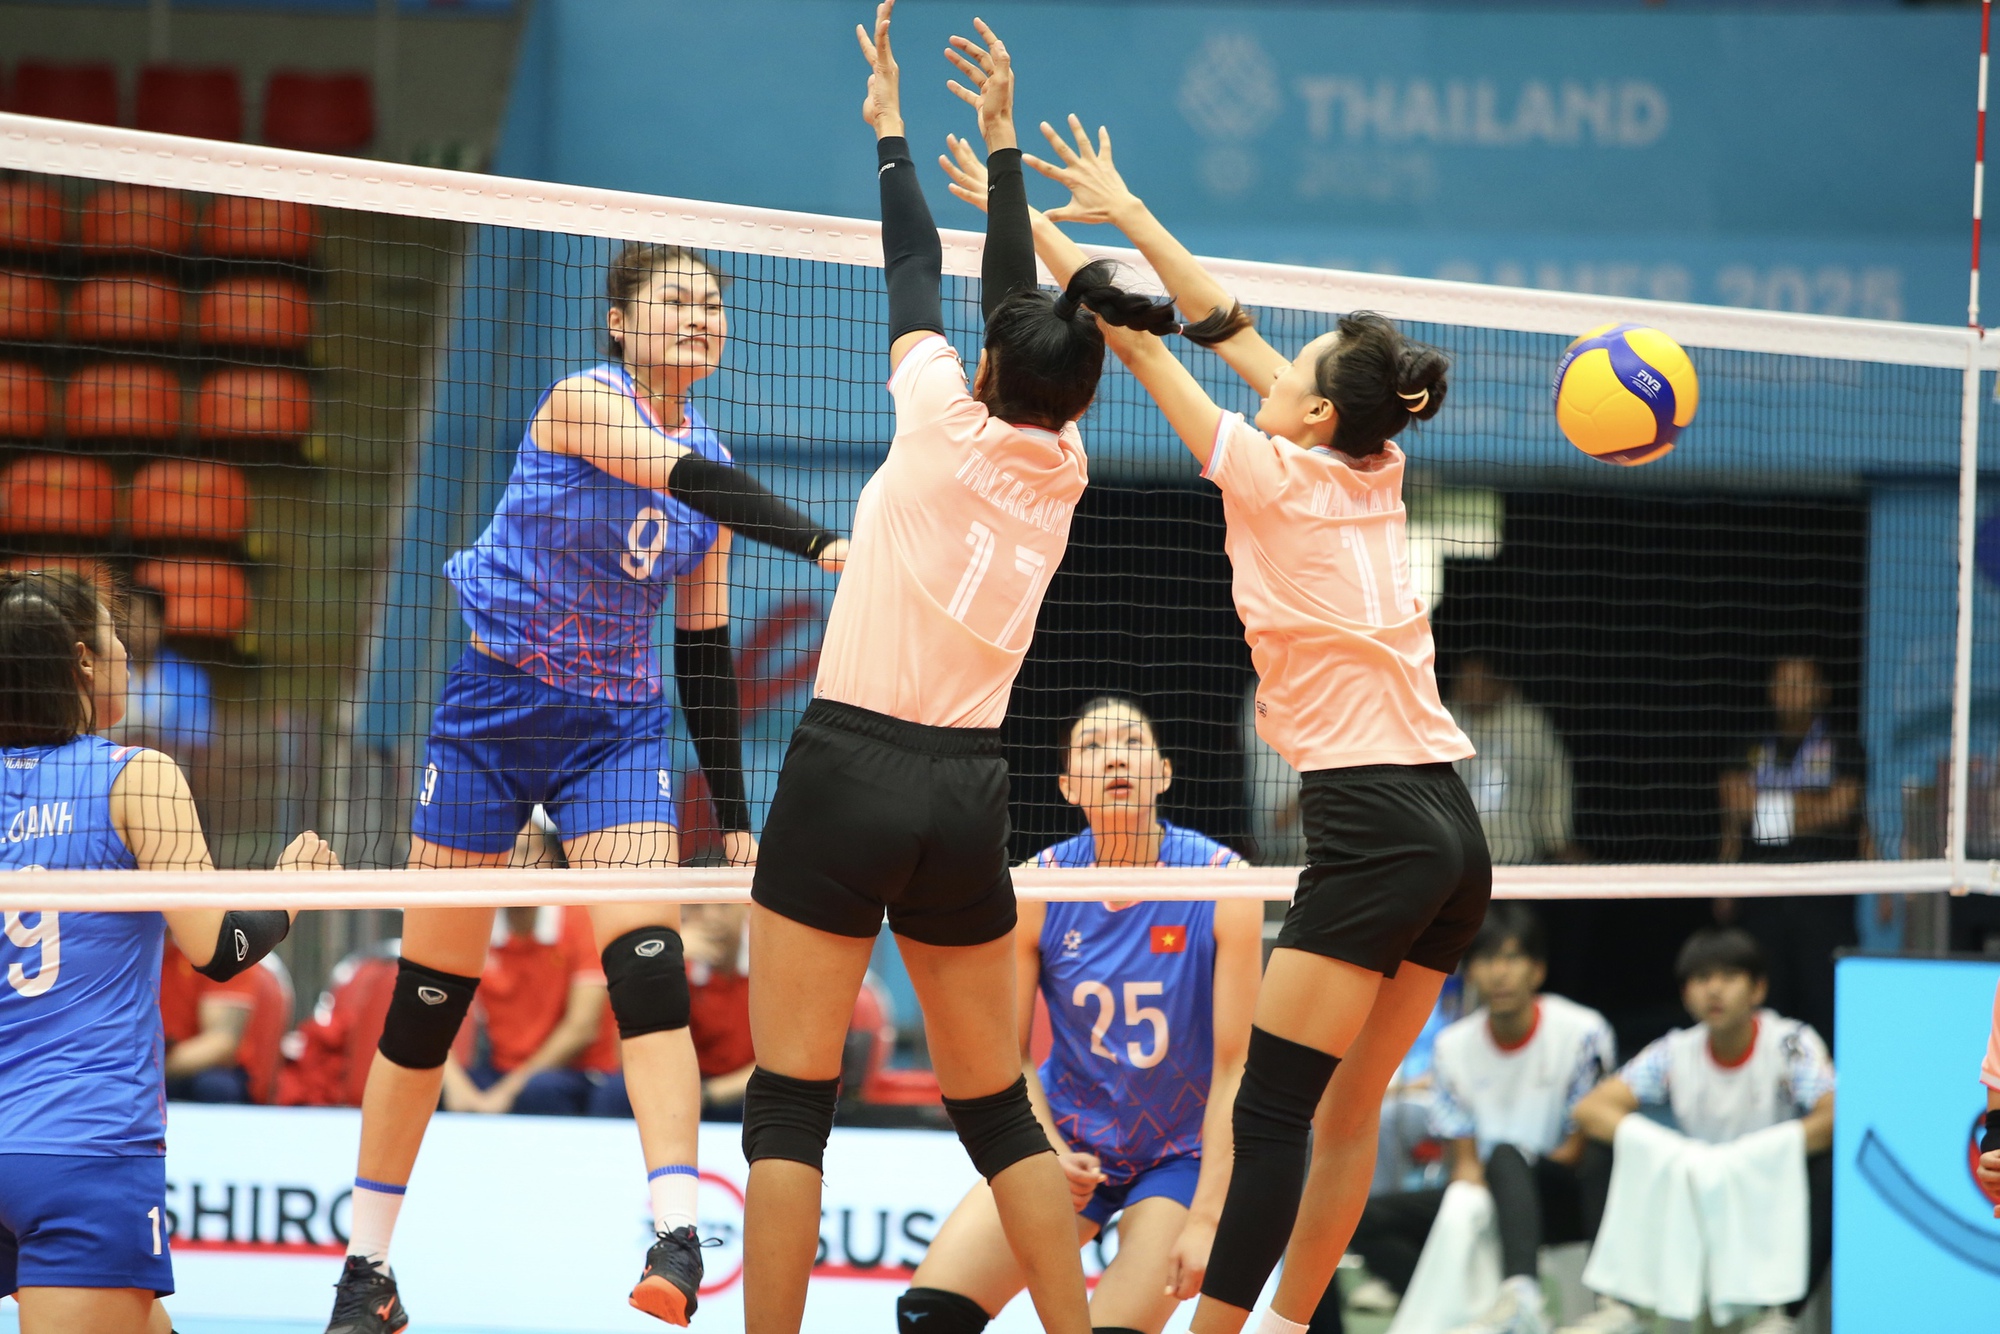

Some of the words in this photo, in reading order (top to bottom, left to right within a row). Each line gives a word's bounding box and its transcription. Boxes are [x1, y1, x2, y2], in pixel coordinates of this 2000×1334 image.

[1298, 79, 1667, 145] THAILAND
[1718, 263, 1904, 320] 2025
[620, 506, 668, 580] 9
[946, 520, 1046, 648] 17
[420, 762, 438, 806] 9
[4, 864, 60, 997] 9
[1072, 980, 1169, 1069] 25
